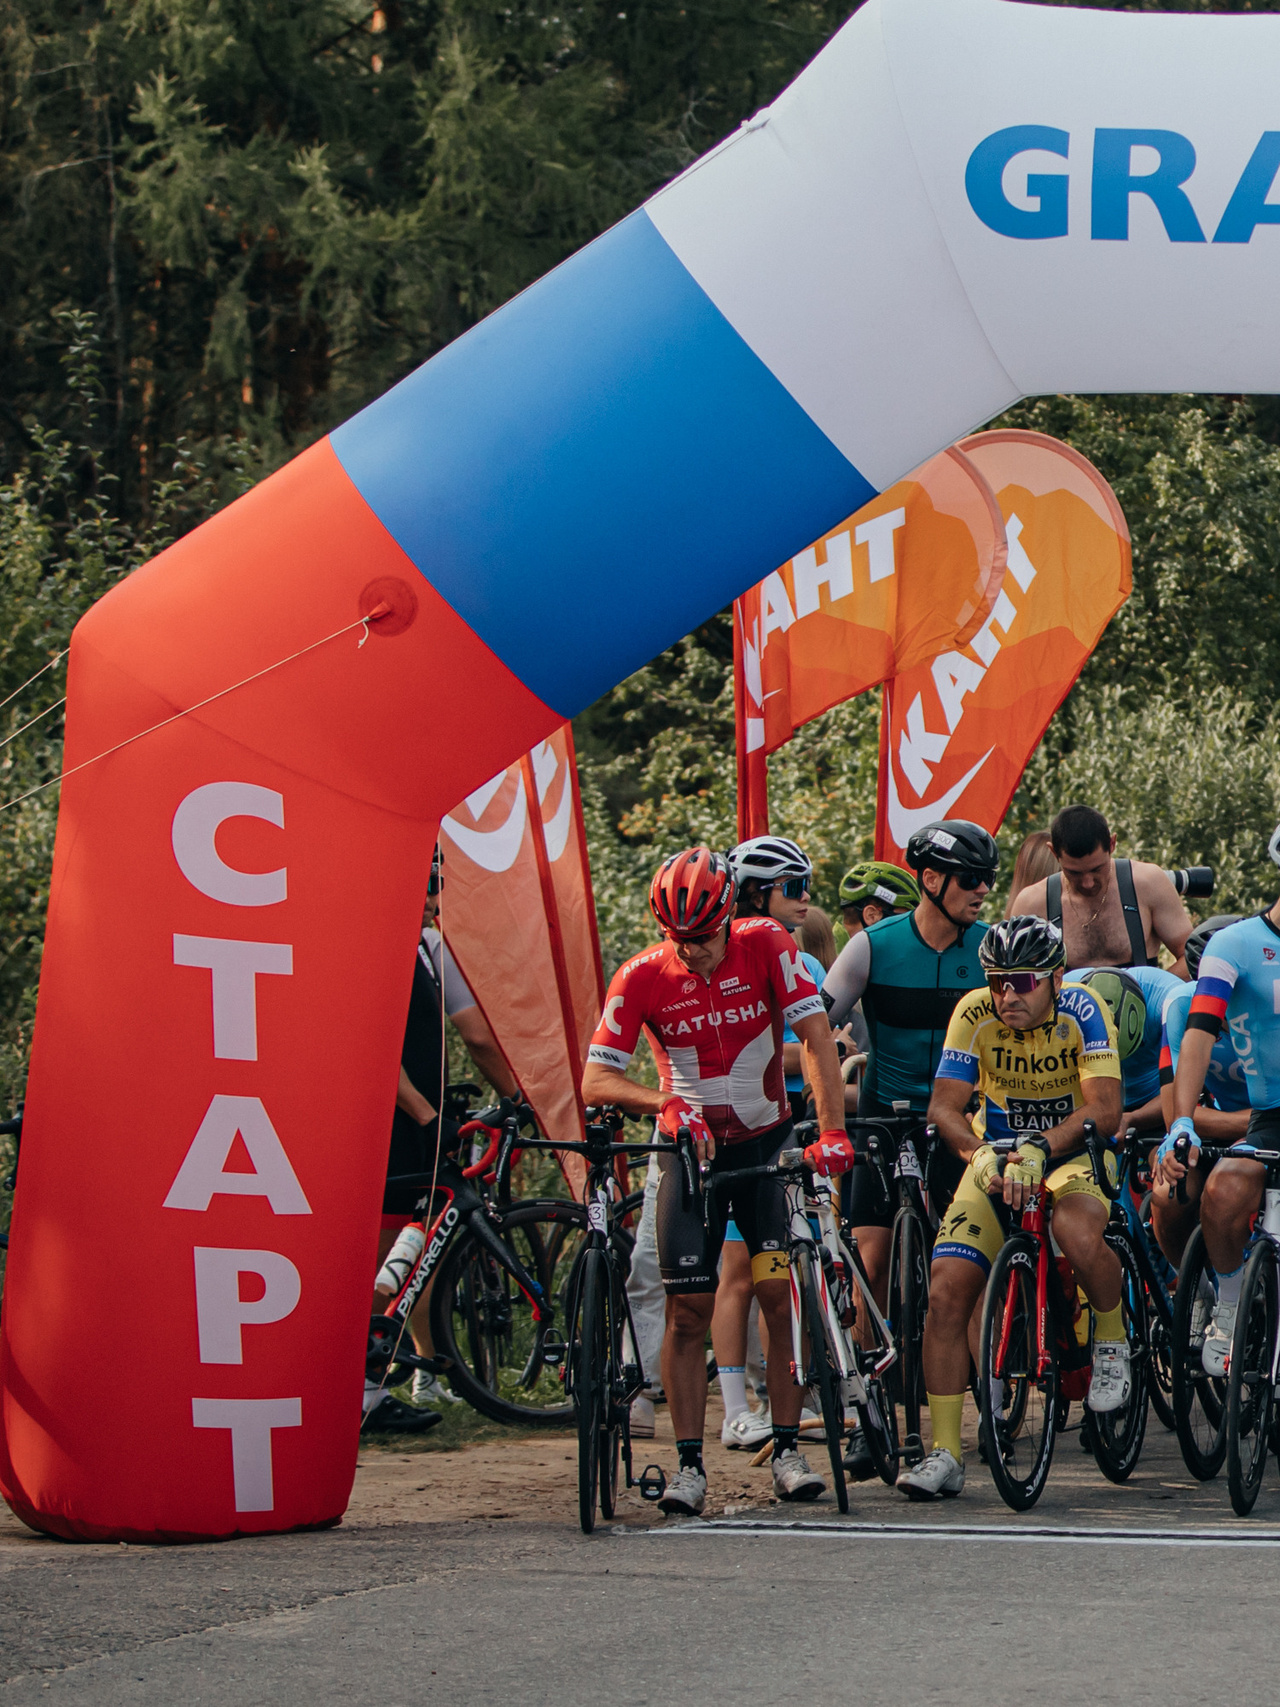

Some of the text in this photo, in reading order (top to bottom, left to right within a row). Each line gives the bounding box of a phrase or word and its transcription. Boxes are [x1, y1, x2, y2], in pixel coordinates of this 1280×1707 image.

[937, 833, 951, 845] 300
[858, 864, 884, 875] KASK
[720, 883, 731, 905] GIRO
[720, 978, 739, 988] TEAM
[722, 985, 752, 996] KATUSHA
[787, 1000, 822, 1019] CANYO
[960, 999, 993, 1026] Tink
[1058, 990, 1095, 1022] SAXO
[660, 1000, 768, 1036] KATUSHA
[1229, 1012, 1258, 1076] RCA
[943, 1050, 972, 1065] SAXO
[992, 1046, 1079, 1074] Tinkoff
[1082, 1053, 1113, 1063] Tinkoff
[988, 1071, 1081, 1093] Credit System
[1012, 1100, 1069, 1113] SAXO
[162, 781, 313, 1512] СТАРТ
[396, 1206, 461, 1319] PINARELLO
